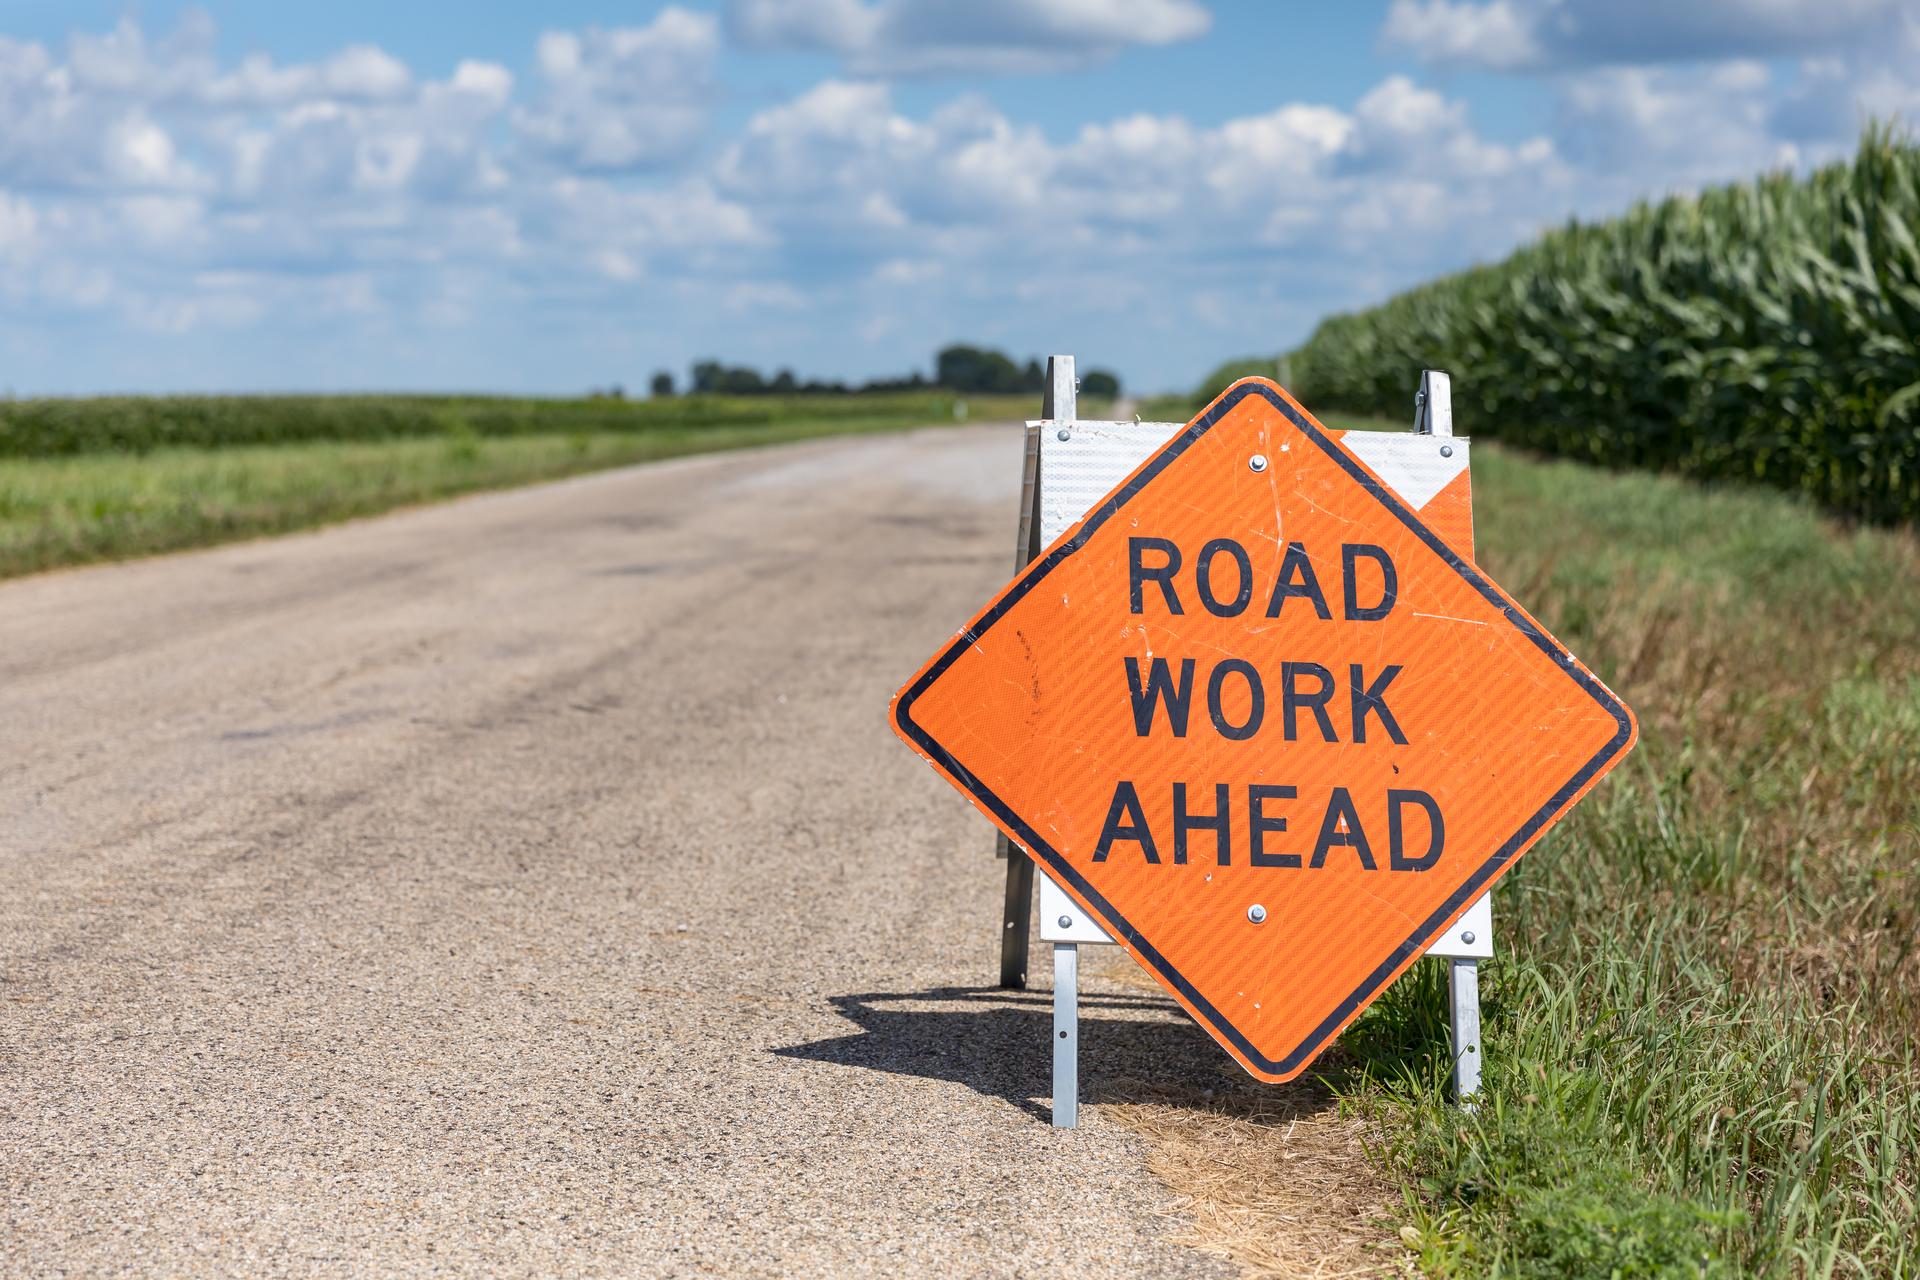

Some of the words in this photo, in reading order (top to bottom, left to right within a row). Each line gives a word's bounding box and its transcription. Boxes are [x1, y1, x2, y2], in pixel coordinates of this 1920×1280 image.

[1129, 537, 1397, 621] ROAD
[1124, 657, 1409, 745] WORK
[1092, 781, 1444, 871] AHEAD
